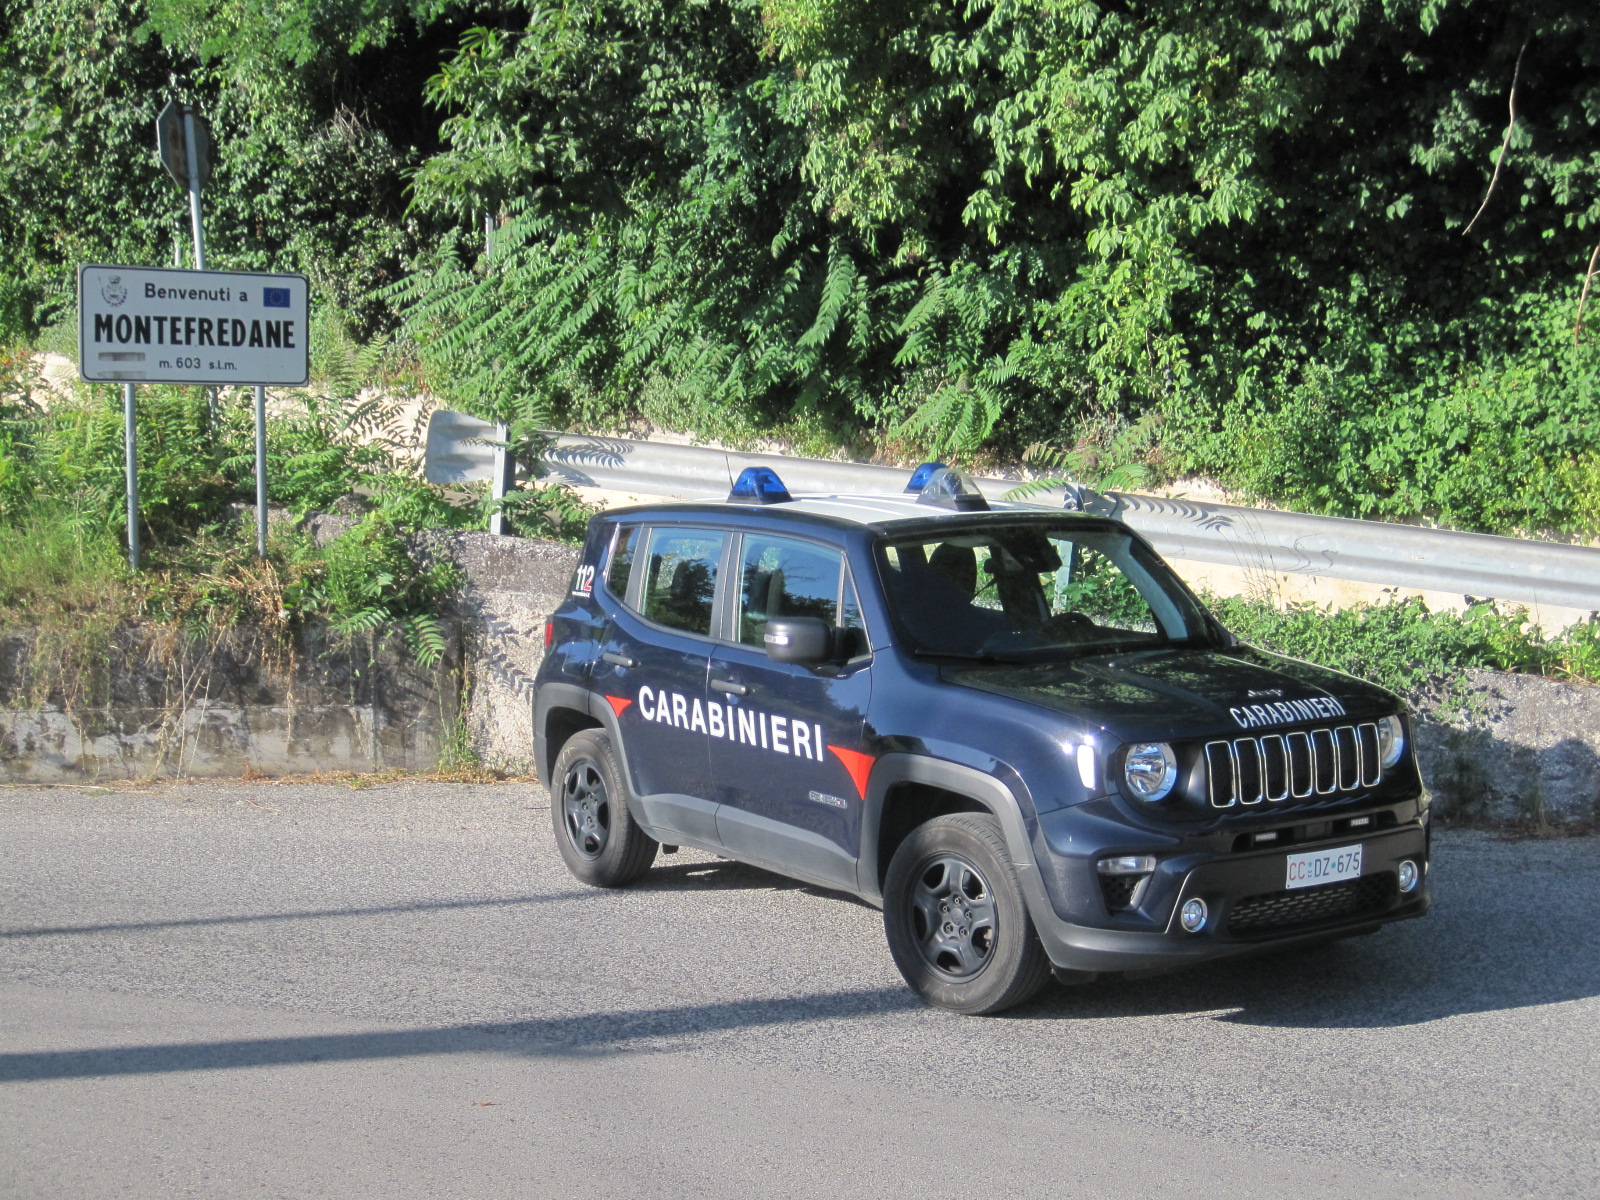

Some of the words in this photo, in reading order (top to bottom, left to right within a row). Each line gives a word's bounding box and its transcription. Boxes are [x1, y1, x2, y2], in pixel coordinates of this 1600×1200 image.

[145, 282, 231, 302] Benvenuti
[239, 290, 249, 302] a
[94, 313, 296, 349] MONTEFREDANE
[159, 360, 173, 369] m.
[176, 357, 201, 370] 603
[208, 361, 238, 371] s.l.m.
[575, 564, 595, 592] 112
[638, 686, 824, 762] CARABINIERI
[1229, 697, 1346, 729] CARABINIERI
